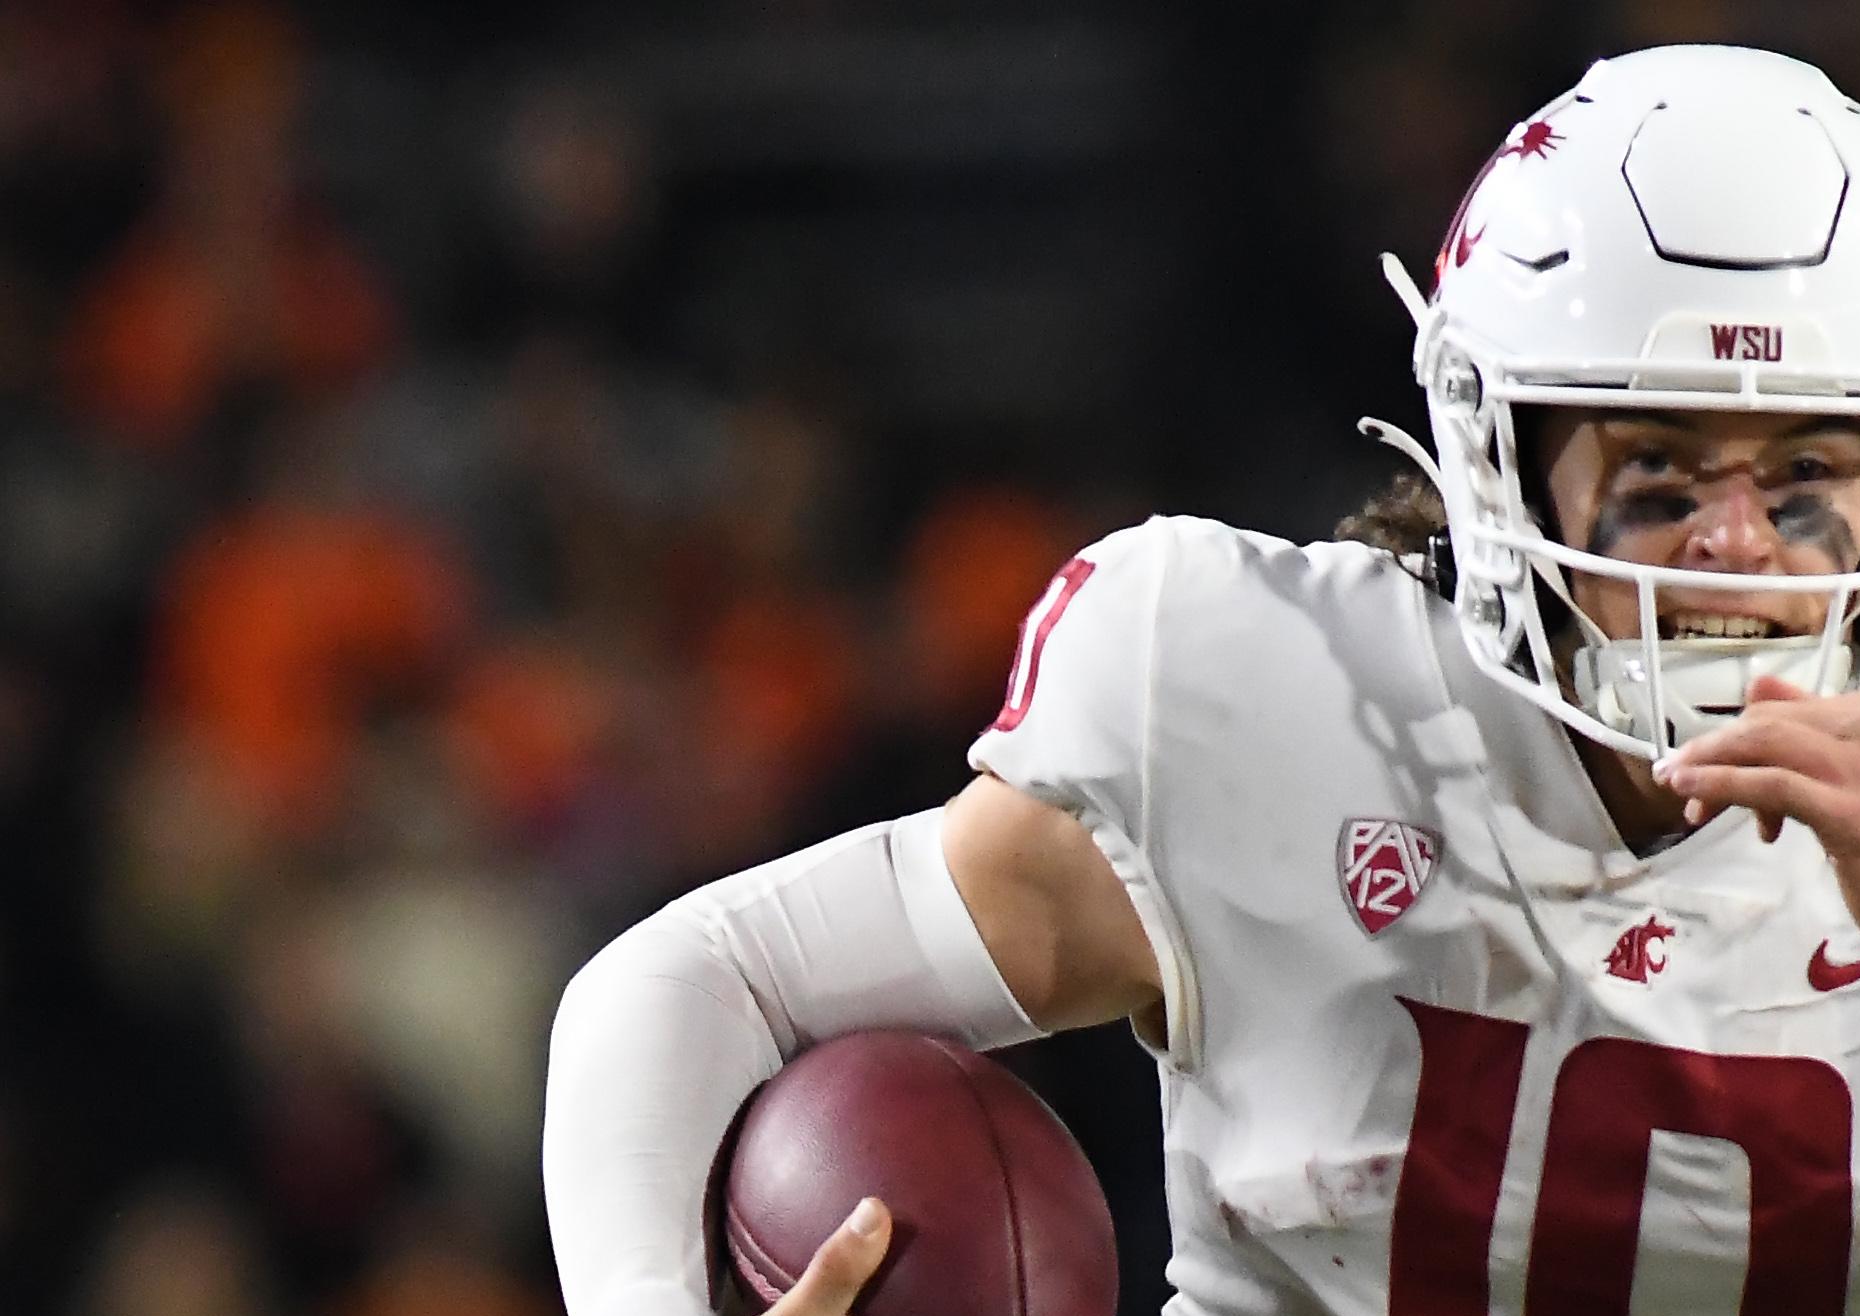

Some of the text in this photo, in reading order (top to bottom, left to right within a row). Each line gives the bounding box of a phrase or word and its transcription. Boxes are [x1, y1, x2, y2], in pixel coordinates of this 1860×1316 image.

[1709, 324, 1782, 362] WSU
[1345, 820, 1433, 896] PAC
[1357, 867, 1406, 914] 12
